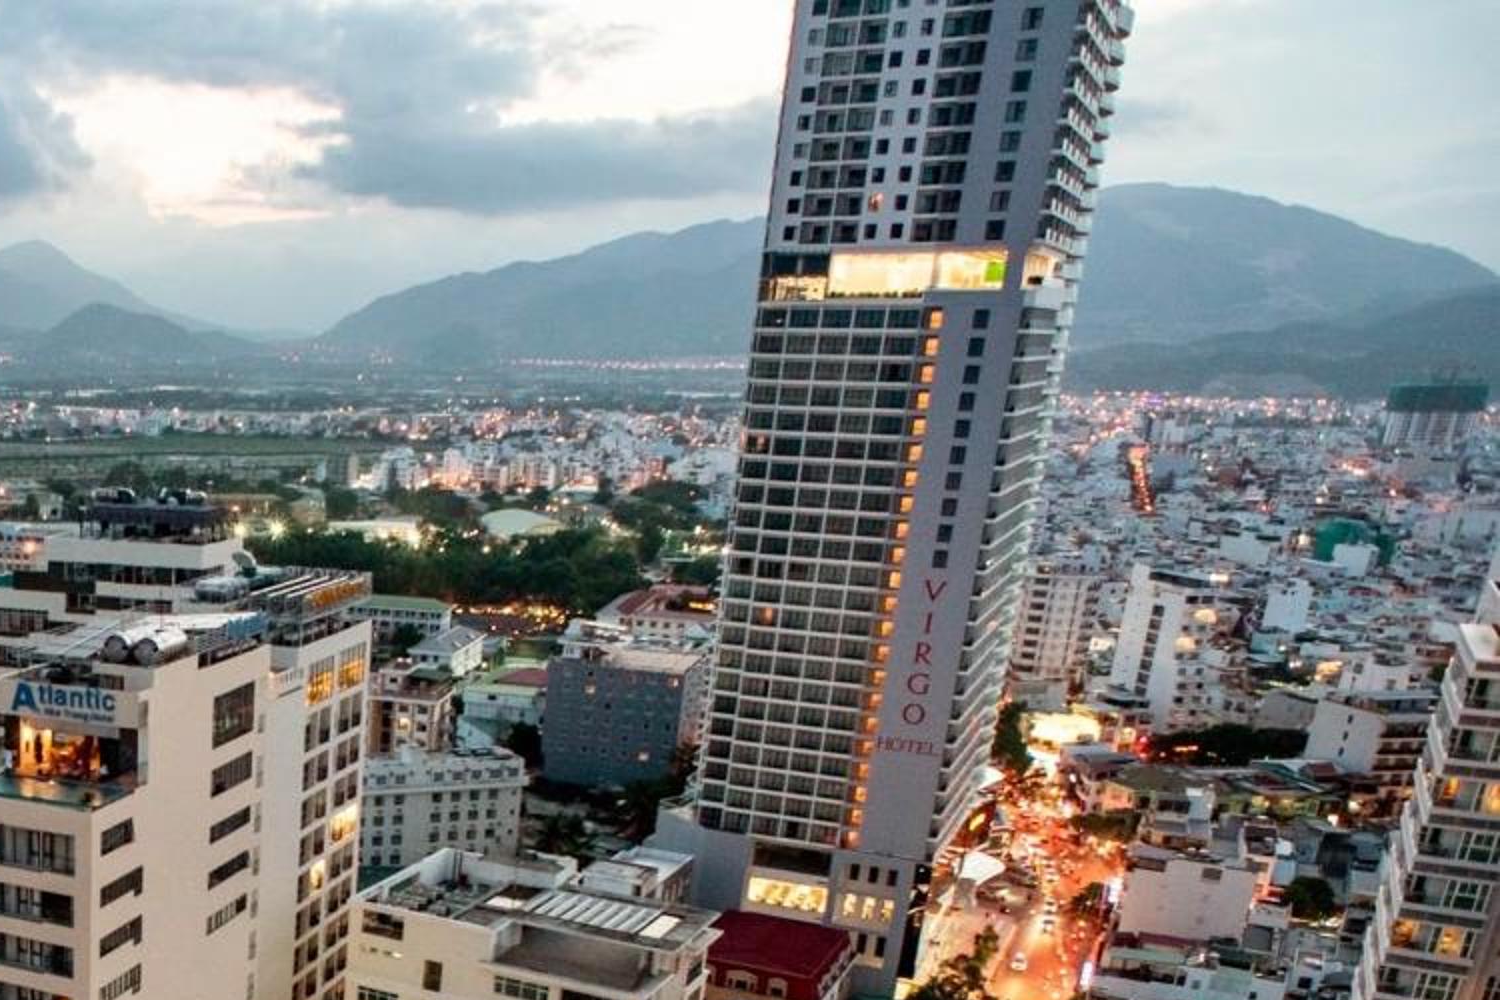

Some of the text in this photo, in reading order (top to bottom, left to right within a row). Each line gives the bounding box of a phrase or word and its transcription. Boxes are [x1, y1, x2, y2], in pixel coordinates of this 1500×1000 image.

[902, 578, 947, 726] VIRGO
[11, 682, 116, 711] Atlantic
[876, 735, 939, 756] HOTEL
